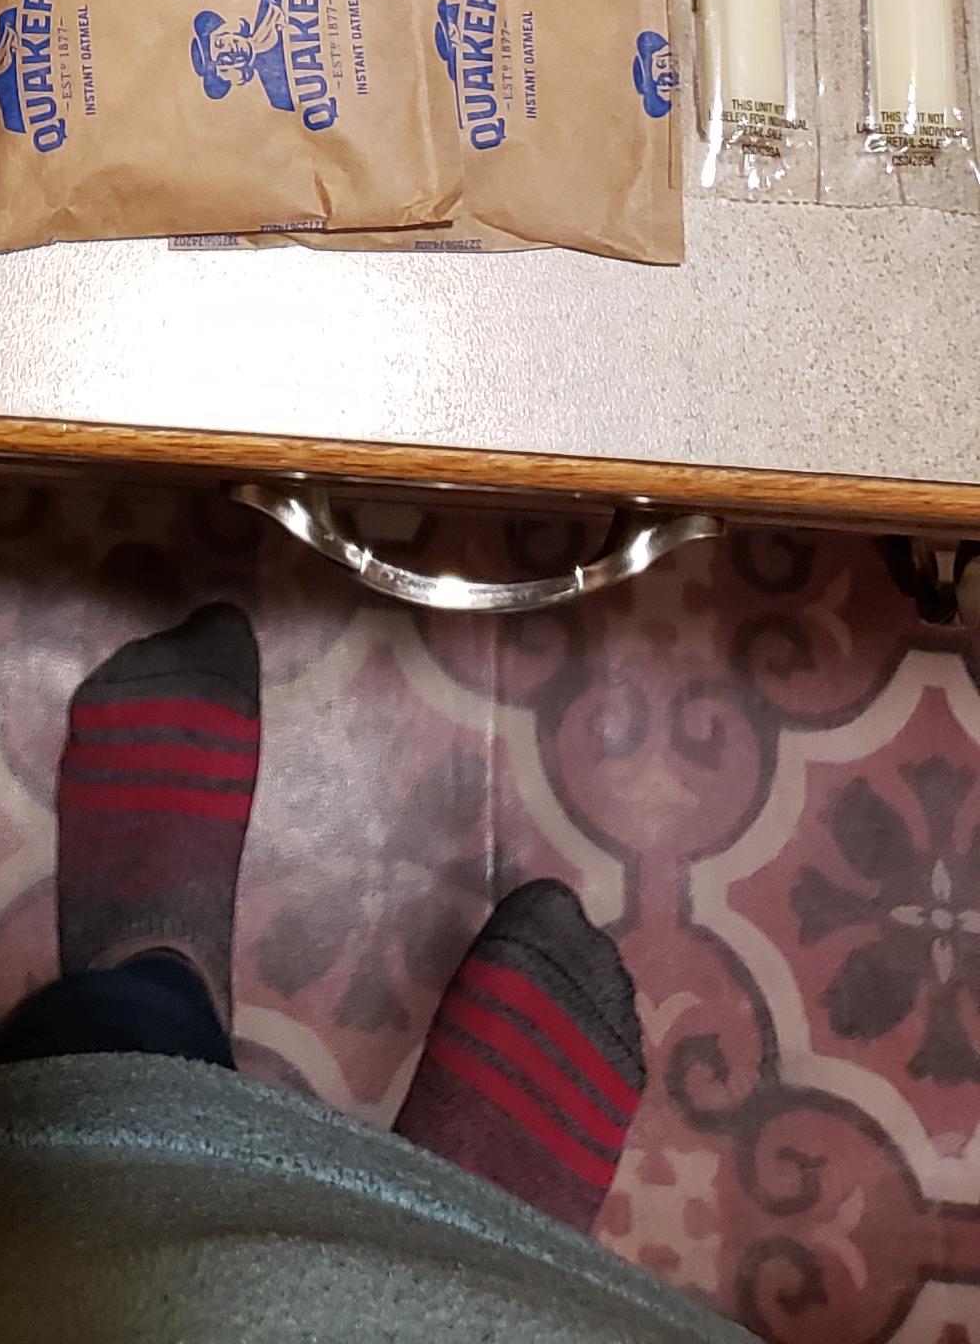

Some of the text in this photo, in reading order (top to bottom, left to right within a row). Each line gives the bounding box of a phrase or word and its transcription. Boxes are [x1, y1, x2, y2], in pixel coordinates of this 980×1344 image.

[77, 5, 96, 116] INSTANT OATMEAL
[354, 43, 368, 95] INSTANT
[522, 11, 537, 119] INSTANT OATMEAL
[732, 99, 752, 111] THIS
[880, 111, 901, 122] THIS
[928, 113, 944, 124] NOT
[918, 138, 941, 150] SALE
